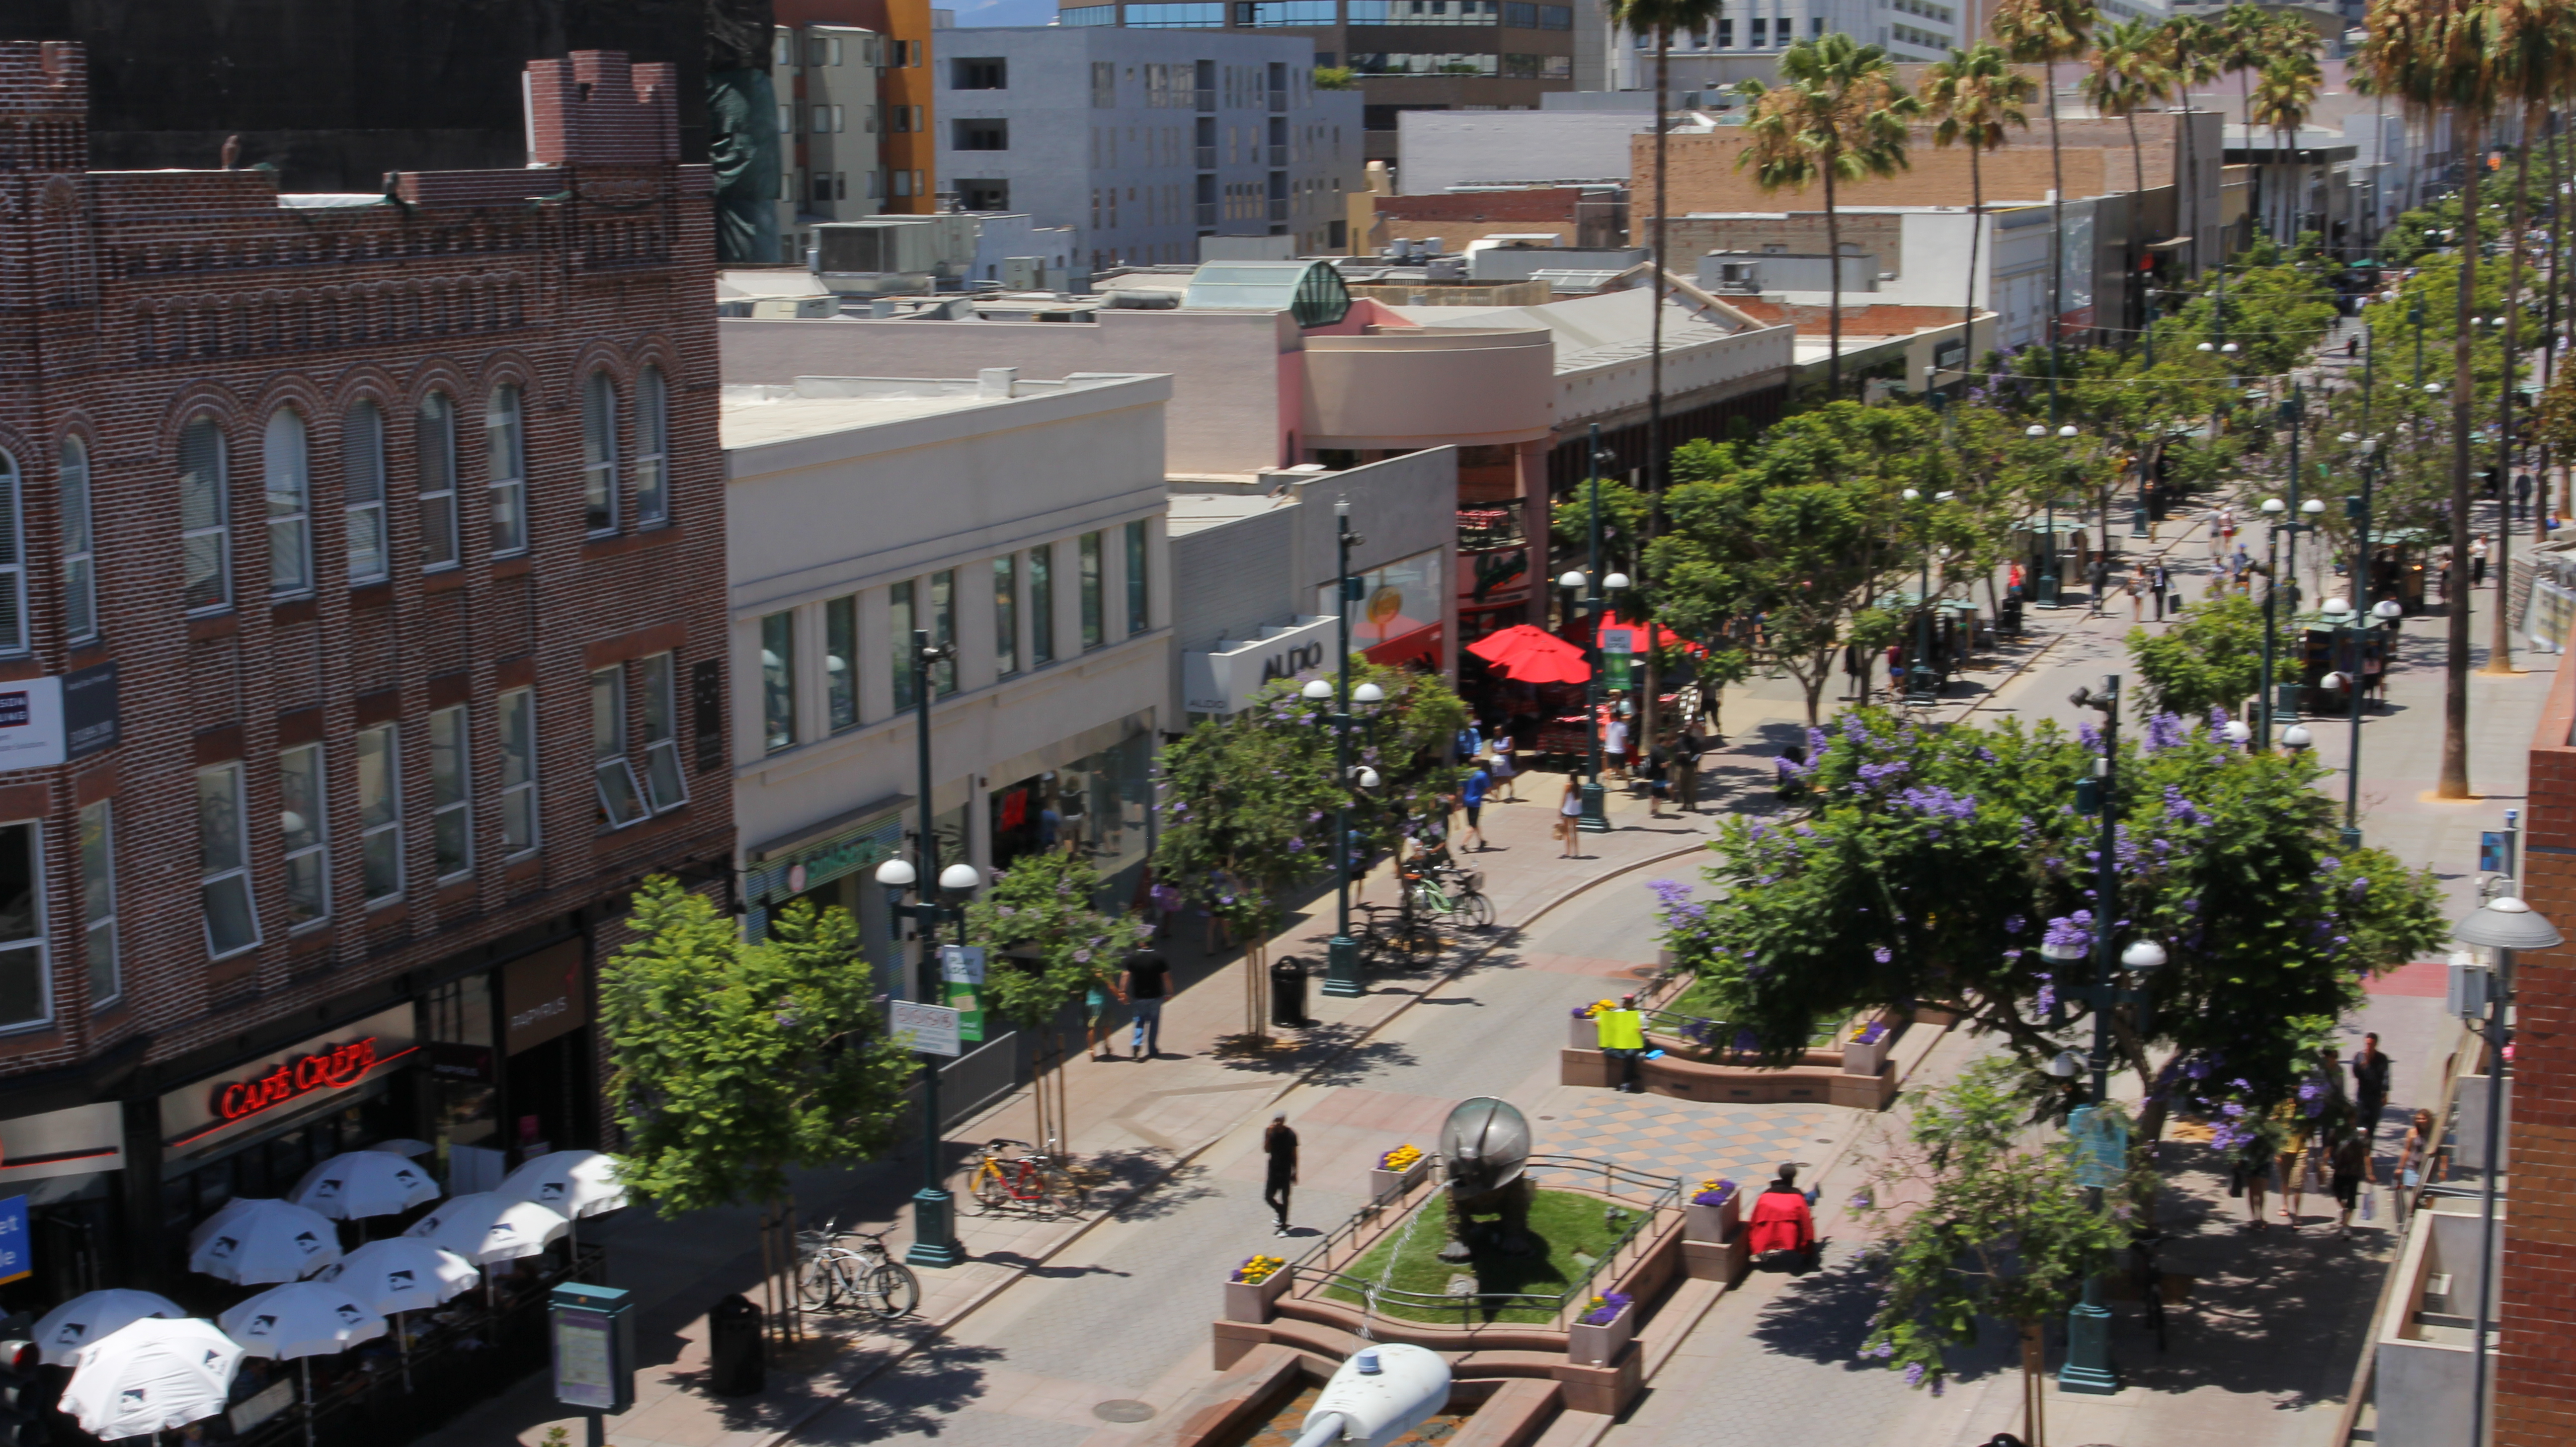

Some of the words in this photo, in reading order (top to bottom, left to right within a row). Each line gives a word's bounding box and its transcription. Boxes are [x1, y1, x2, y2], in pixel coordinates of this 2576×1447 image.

[1261, 640, 1323, 686] ALDO
[1189, 699, 1227, 709] ALDO
[221, 1065, 292, 1119] CAFÉ
